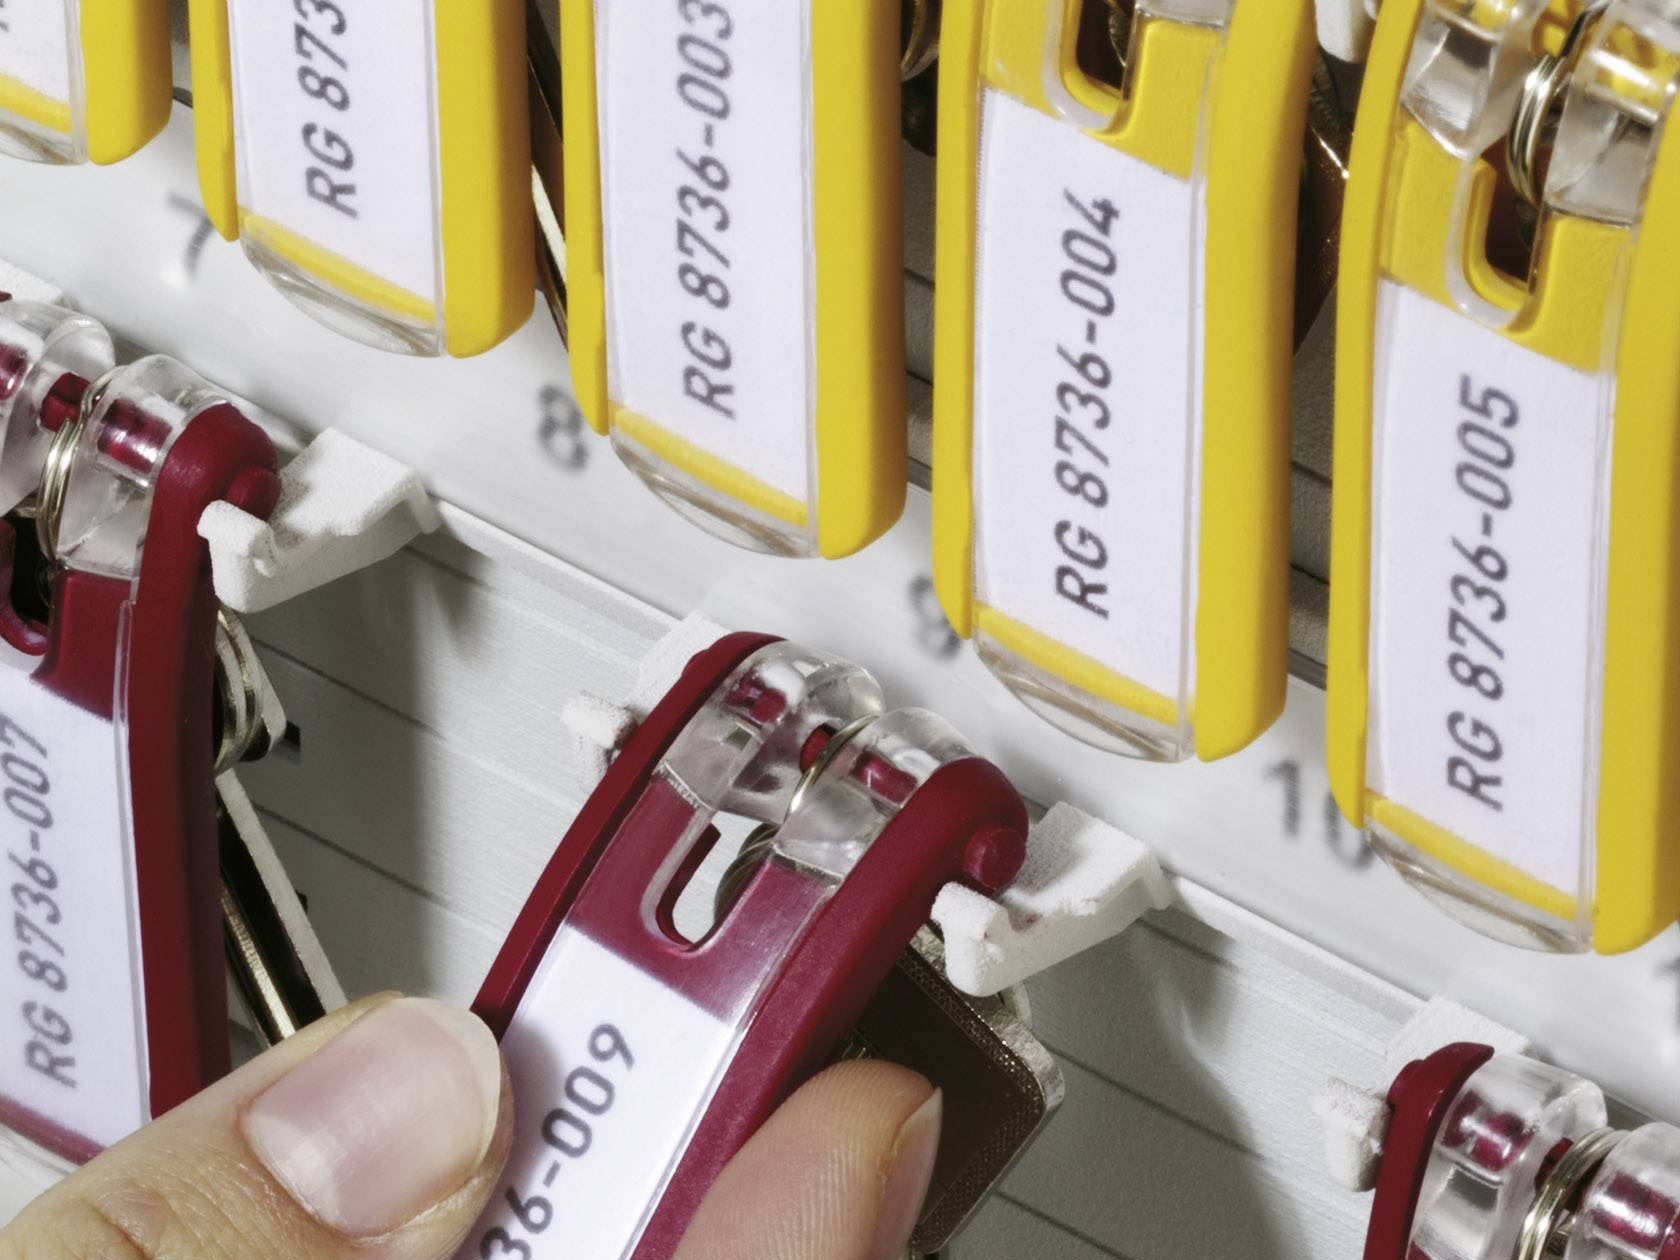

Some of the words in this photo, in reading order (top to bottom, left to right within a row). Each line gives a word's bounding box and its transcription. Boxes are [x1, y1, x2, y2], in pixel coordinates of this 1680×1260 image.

[301, 122, 358, 219] RG
[675, 0, 733, 310] 8736-003
[680, 321, 736, 420] RG
[1053, 190, 1120, 509] 8736-004
[537, 385, 588, 472] 8
[1053, 520, 1110, 620] RG
[1446, 374, 1521, 702] 8736-005
[1446, 710, 1505, 812] RG
[0, 713, 68, 992] 8736-007
[22, 1002, 76, 1087] RG
